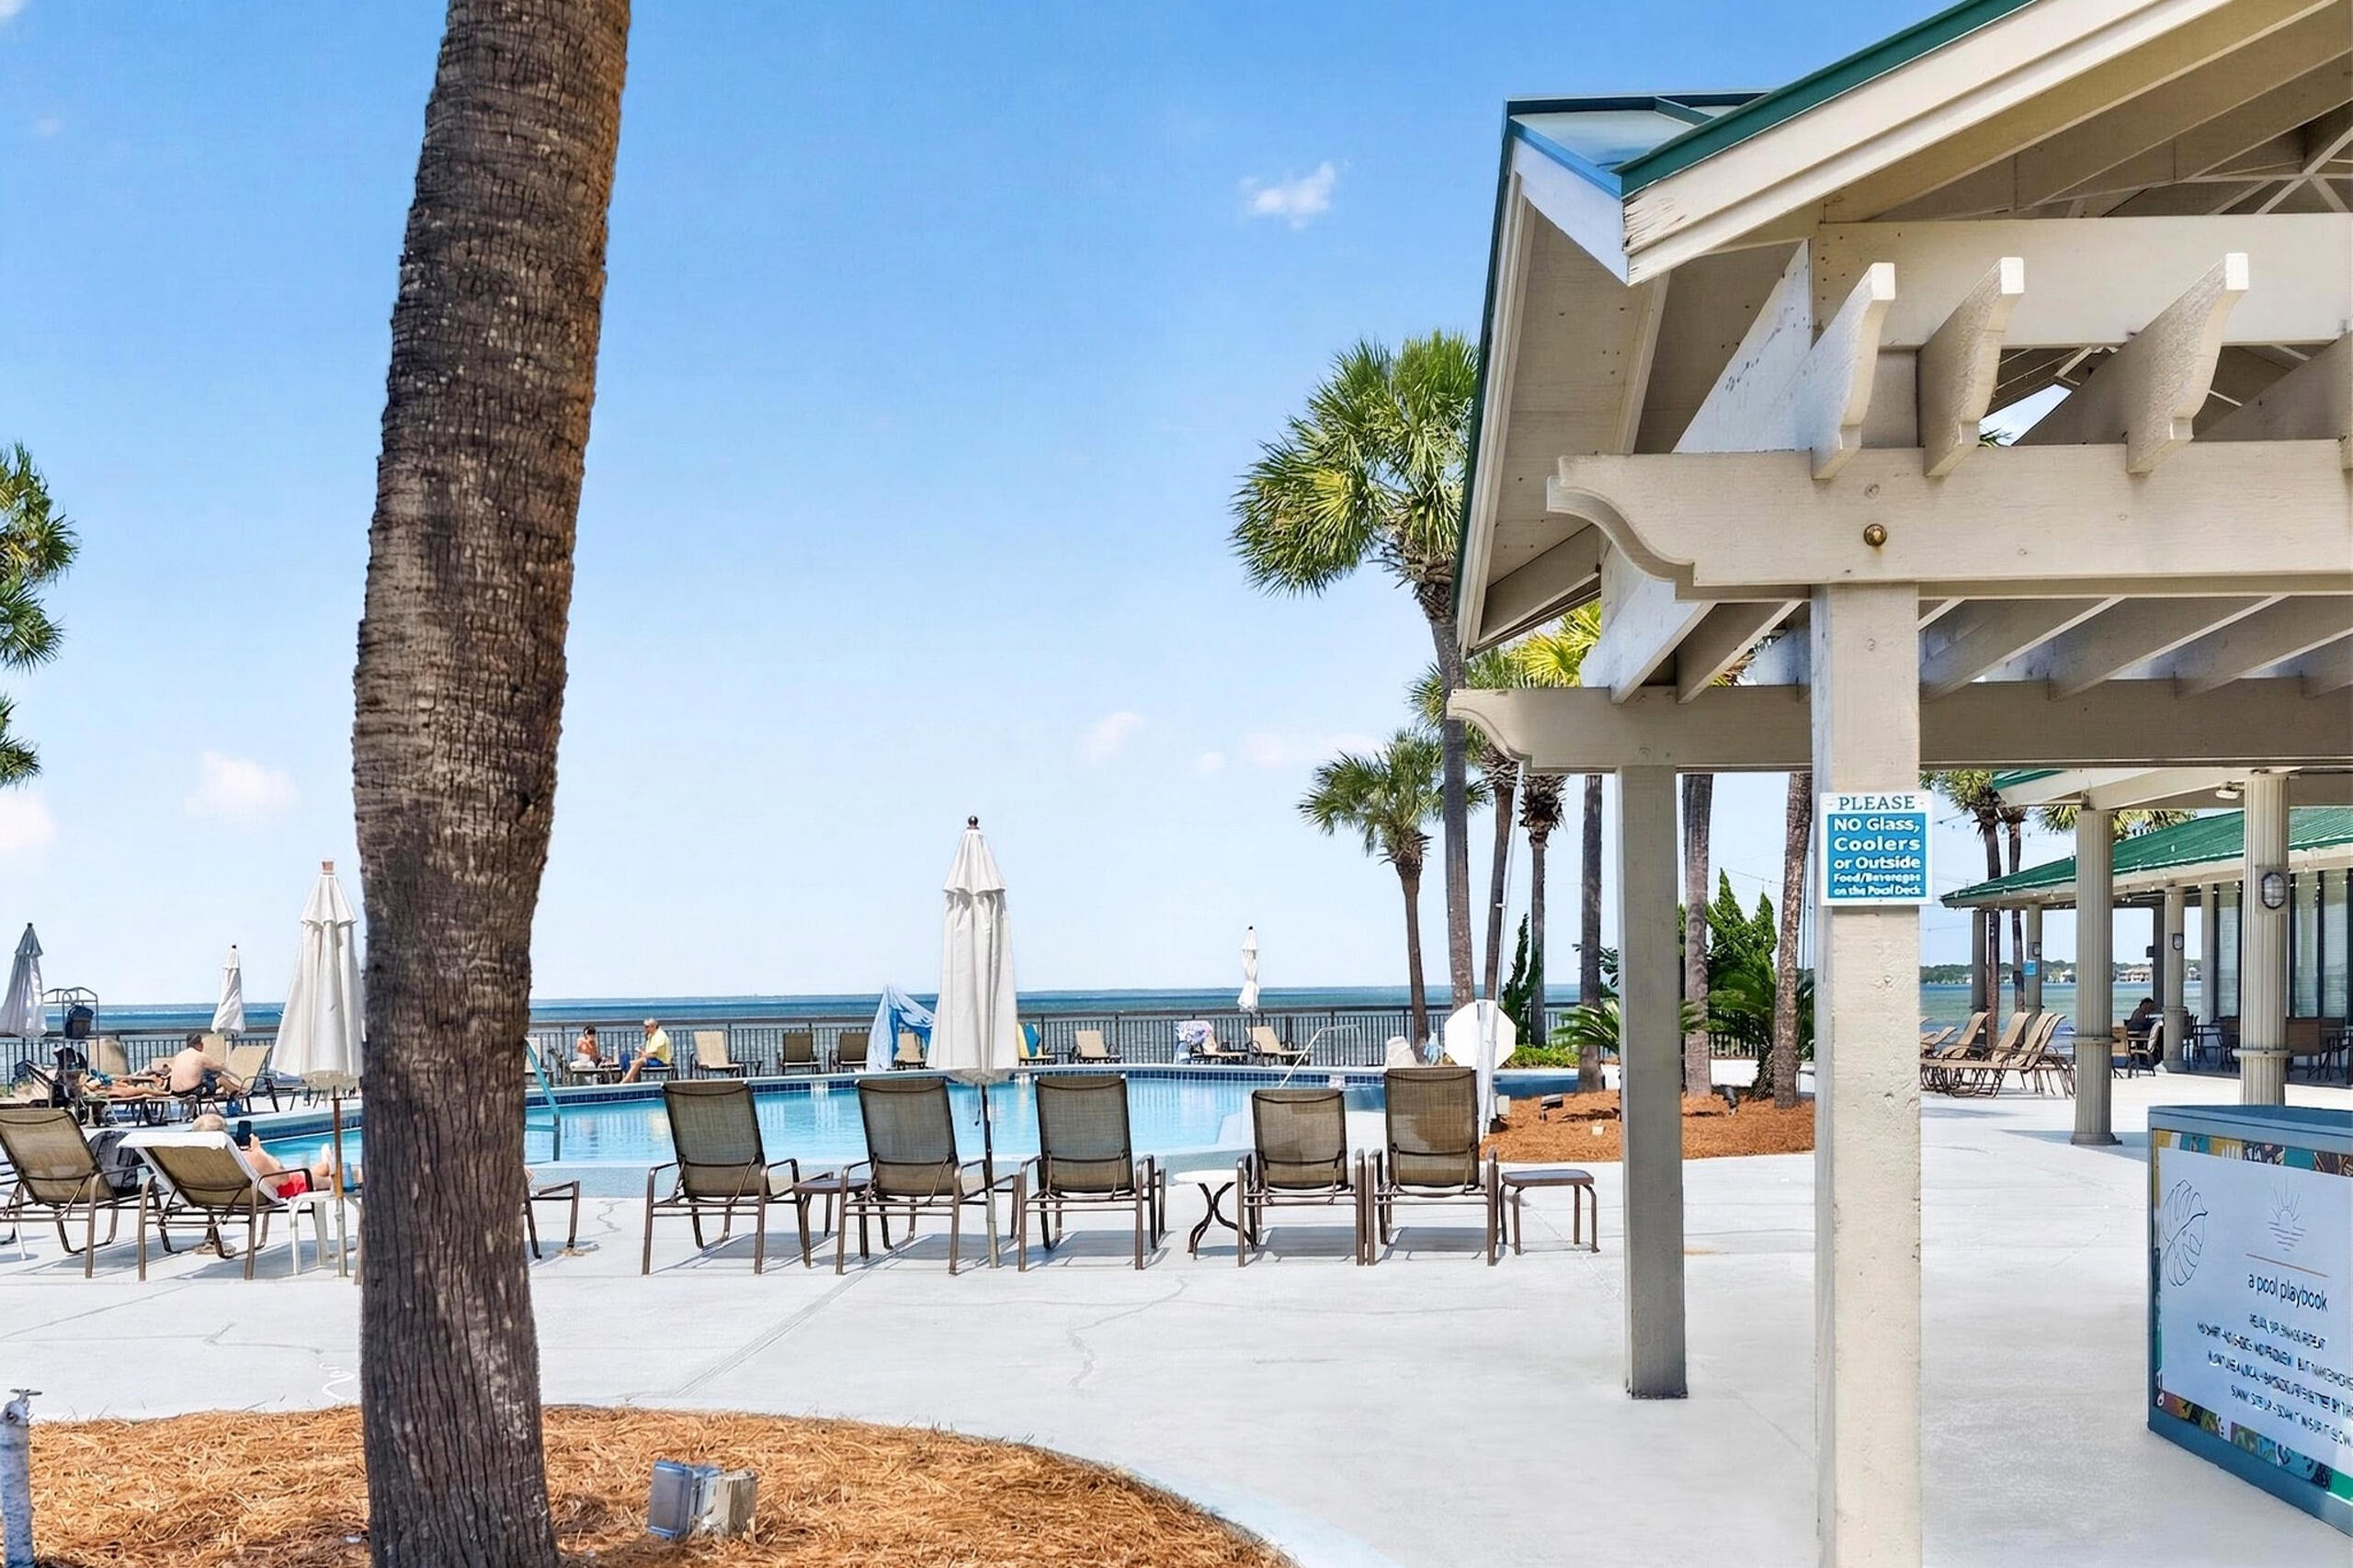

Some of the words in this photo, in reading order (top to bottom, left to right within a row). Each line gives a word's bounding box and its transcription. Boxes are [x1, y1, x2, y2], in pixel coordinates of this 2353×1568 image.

[1838, 796, 1915, 810] PLEASE
[1866, 816, 1921, 833] Glass,
[1834, 835, 1921, 852] Coolers
[1834, 858, 1853, 869] or
[1855, 856, 1921, 869] Outside
[1868, 884, 1893, 895] Pool
[2248, 1274, 2255, 1289] a
[2256, 1276, 2279, 1297] pool
[2279, 1278, 2328, 1312] playbook
